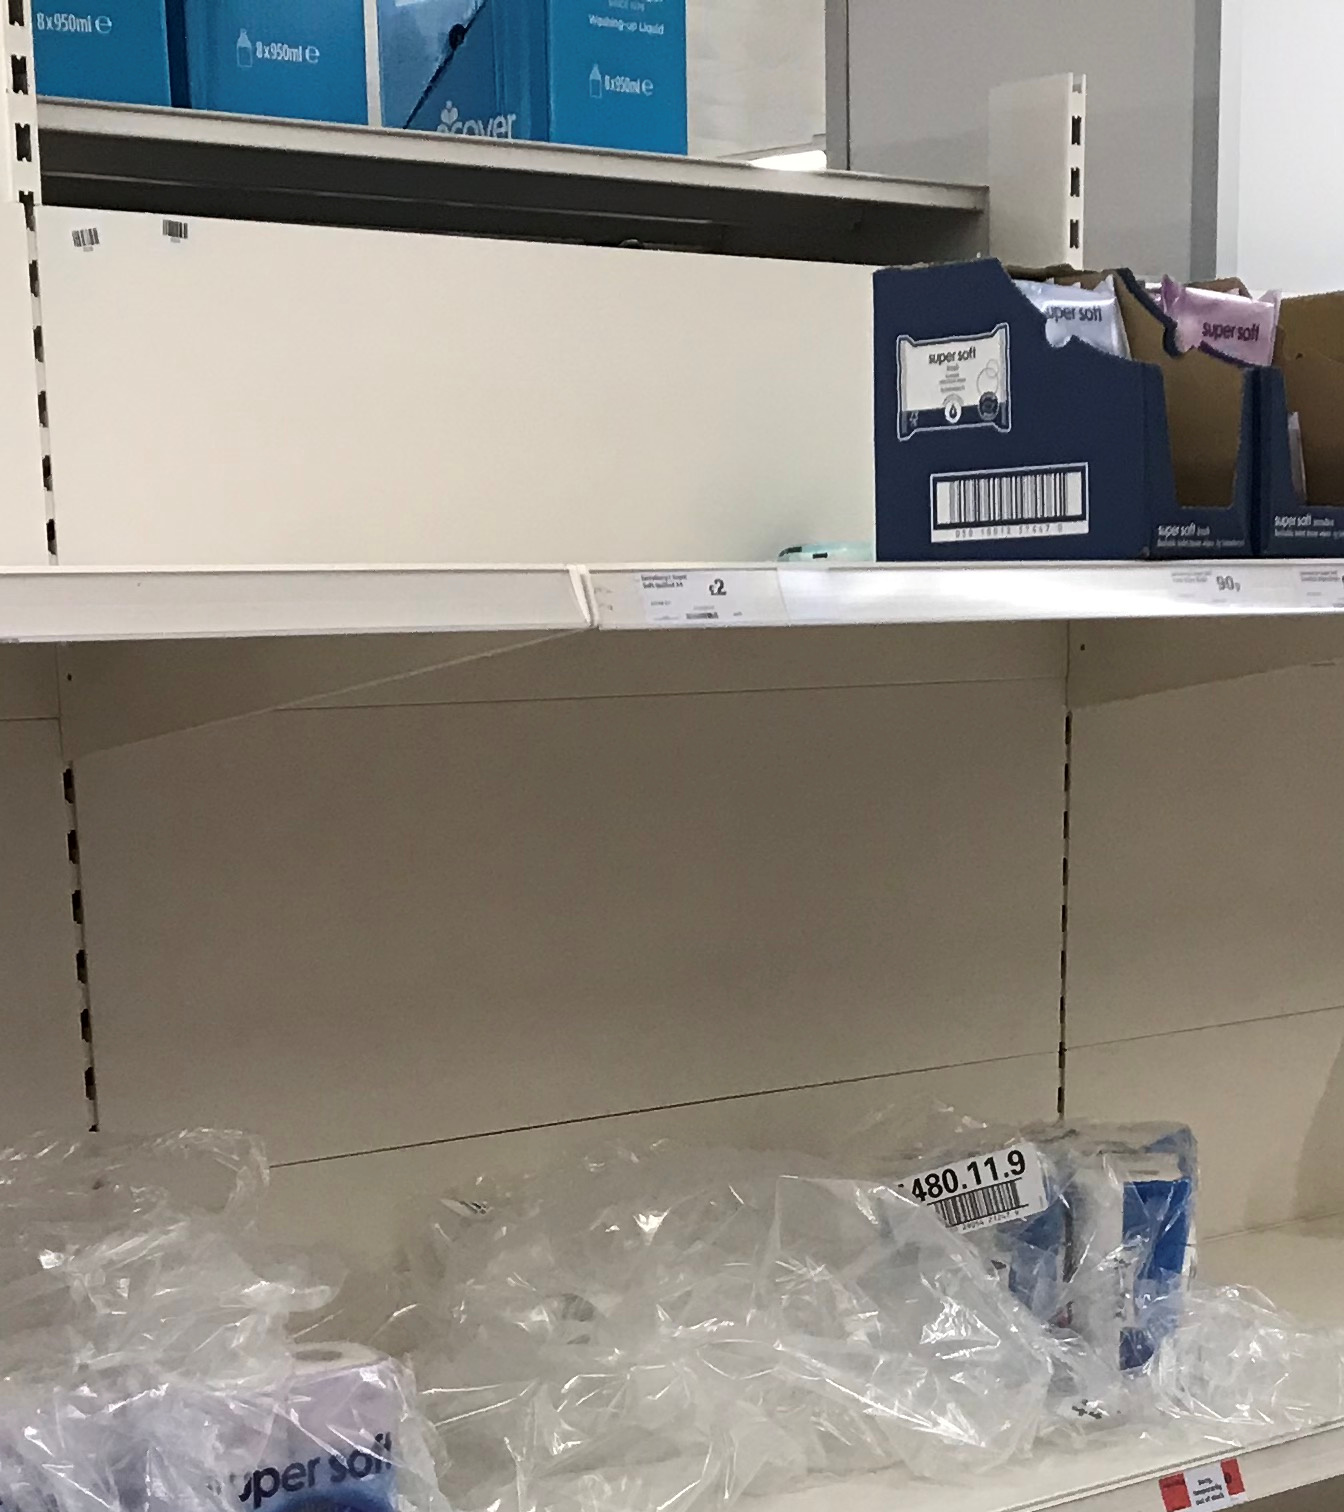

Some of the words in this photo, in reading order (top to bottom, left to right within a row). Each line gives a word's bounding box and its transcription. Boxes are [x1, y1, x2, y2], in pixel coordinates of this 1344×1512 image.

[1202, 321, 1234, 341] super
[1236, 322, 1259, 341] soft
[929, 350, 956, 365] super
[958, 346, 976, 361] soft
[1216, 575, 1241, 592] 90p
[912, 1150, 1026, 1202] 480.11.9
[239, 1457, 321, 1509] uper
